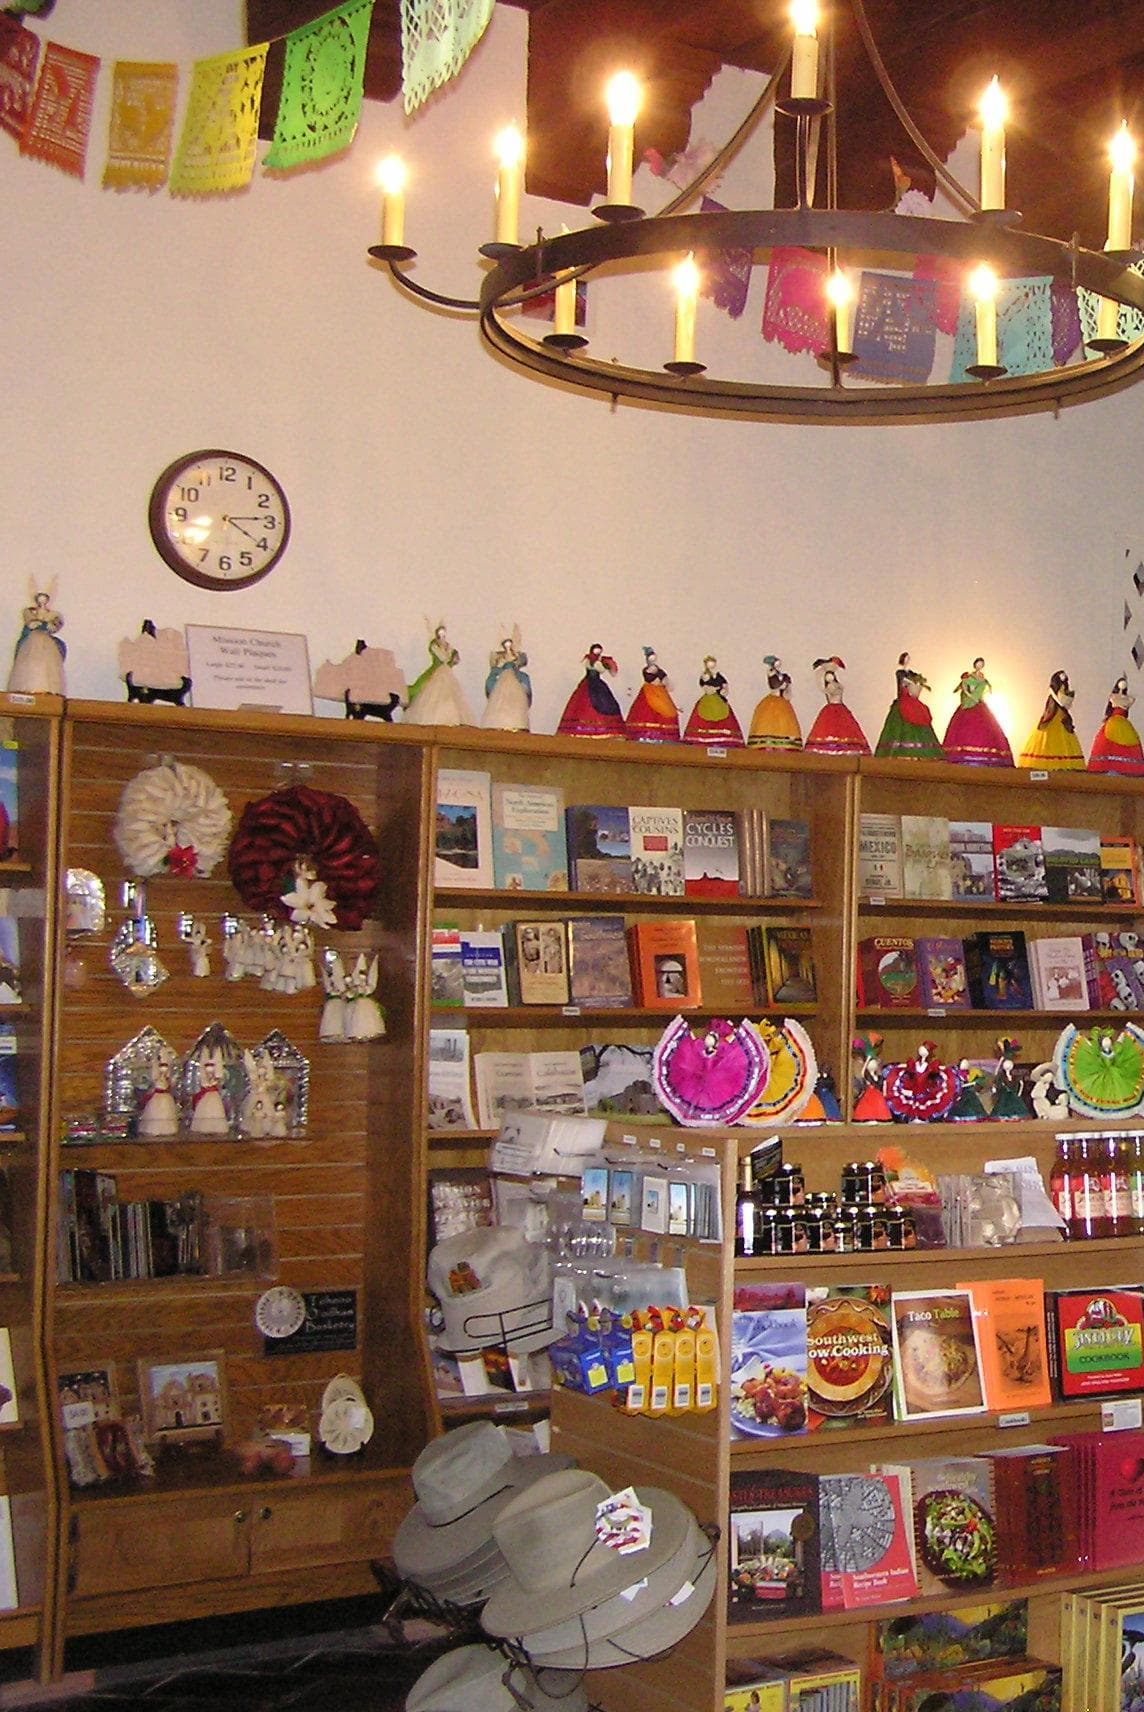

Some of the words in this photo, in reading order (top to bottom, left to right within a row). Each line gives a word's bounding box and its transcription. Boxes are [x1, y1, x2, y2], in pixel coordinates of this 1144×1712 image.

[219, 466, 236, 481] 12
[247, 475, 253, 490] 1
[181, 487, 199, 502] 10
[258, 493, 270, 508] 2
[175, 507, 188, 522] 9
[263, 515, 276, 530] 3
[256, 537, 269, 552] 4
[198, 548, 209, 562] 7
[240, 552, 252, 566] 5
[219, 556, 231, 571] 6
[632, 816, 679, 825] CAPTIVES
[633, 825, 680, 834] COUSINS
[686, 822, 734, 834] CYCLES
[685, 835, 735, 848] CONQUEST
[859, 840, 897, 853] MEXICO
[874, 937, 914, 947] CUENTOS
[907, 1310, 932, 1322] Taco
[932, 1308, 960, 1320] Table
[806, 1332, 878, 1346] Southwest
[832, 1343, 889, 1358] Cooking
[1079, 1352, 1130, 1363] COOKBOOK
